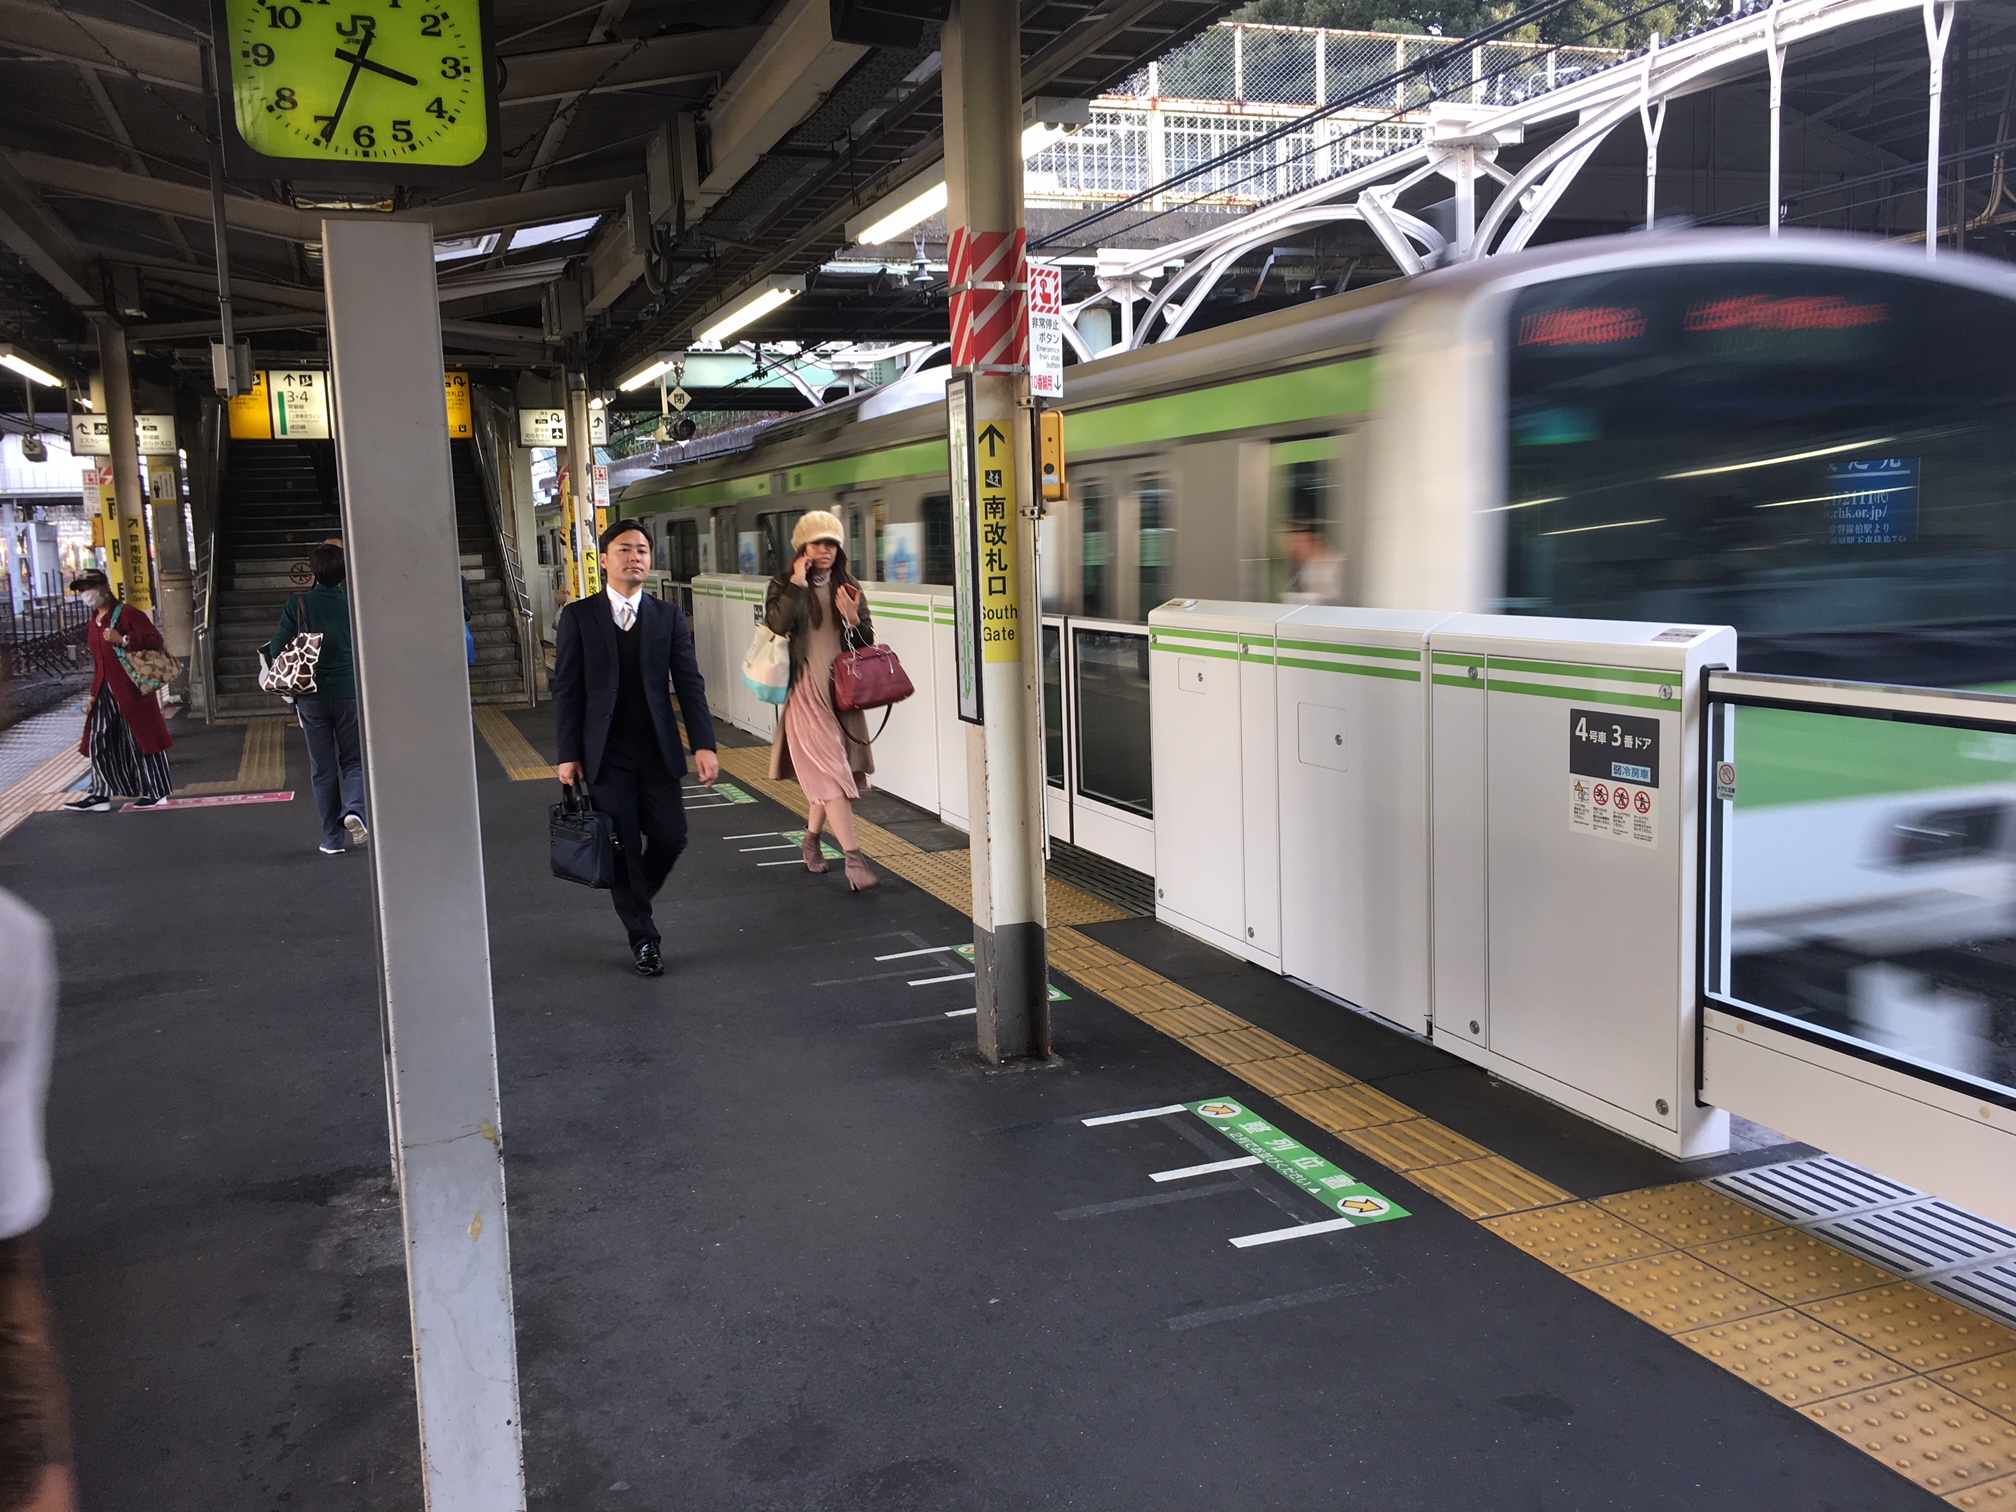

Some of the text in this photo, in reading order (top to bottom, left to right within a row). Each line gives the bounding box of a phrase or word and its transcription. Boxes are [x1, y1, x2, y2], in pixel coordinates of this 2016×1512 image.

[267, 6, 301, 29] 10
[420, 14, 442, 37] 2
[251, 43, 275, 67] 9
[440, 57, 462, 80] 3
[275, 87, 298, 110] 8
[425, 97, 448, 119] 4
[314, 115, 333, 139] 7
[353, 125, 376, 148] 6
[392, 120, 414, 143] 5
[1031, 317, 1060, 331] 非常停止
[1036, 344, 1060, 353] Emergency
[1039, 332, 1060, 344] ボタン
[1046, 361, 1060, 369] button
[674, 393, 684, 404] 閉
[983, 495, 1008, 596] 南改札口
[130, 545, 144, 584] 南改札口
[984, 627, 1015, 641] Gate
[1575, 717, 1652, 750] 4号車 3番ドア
[1613, 764, 1649, 779] 弱冷房車
